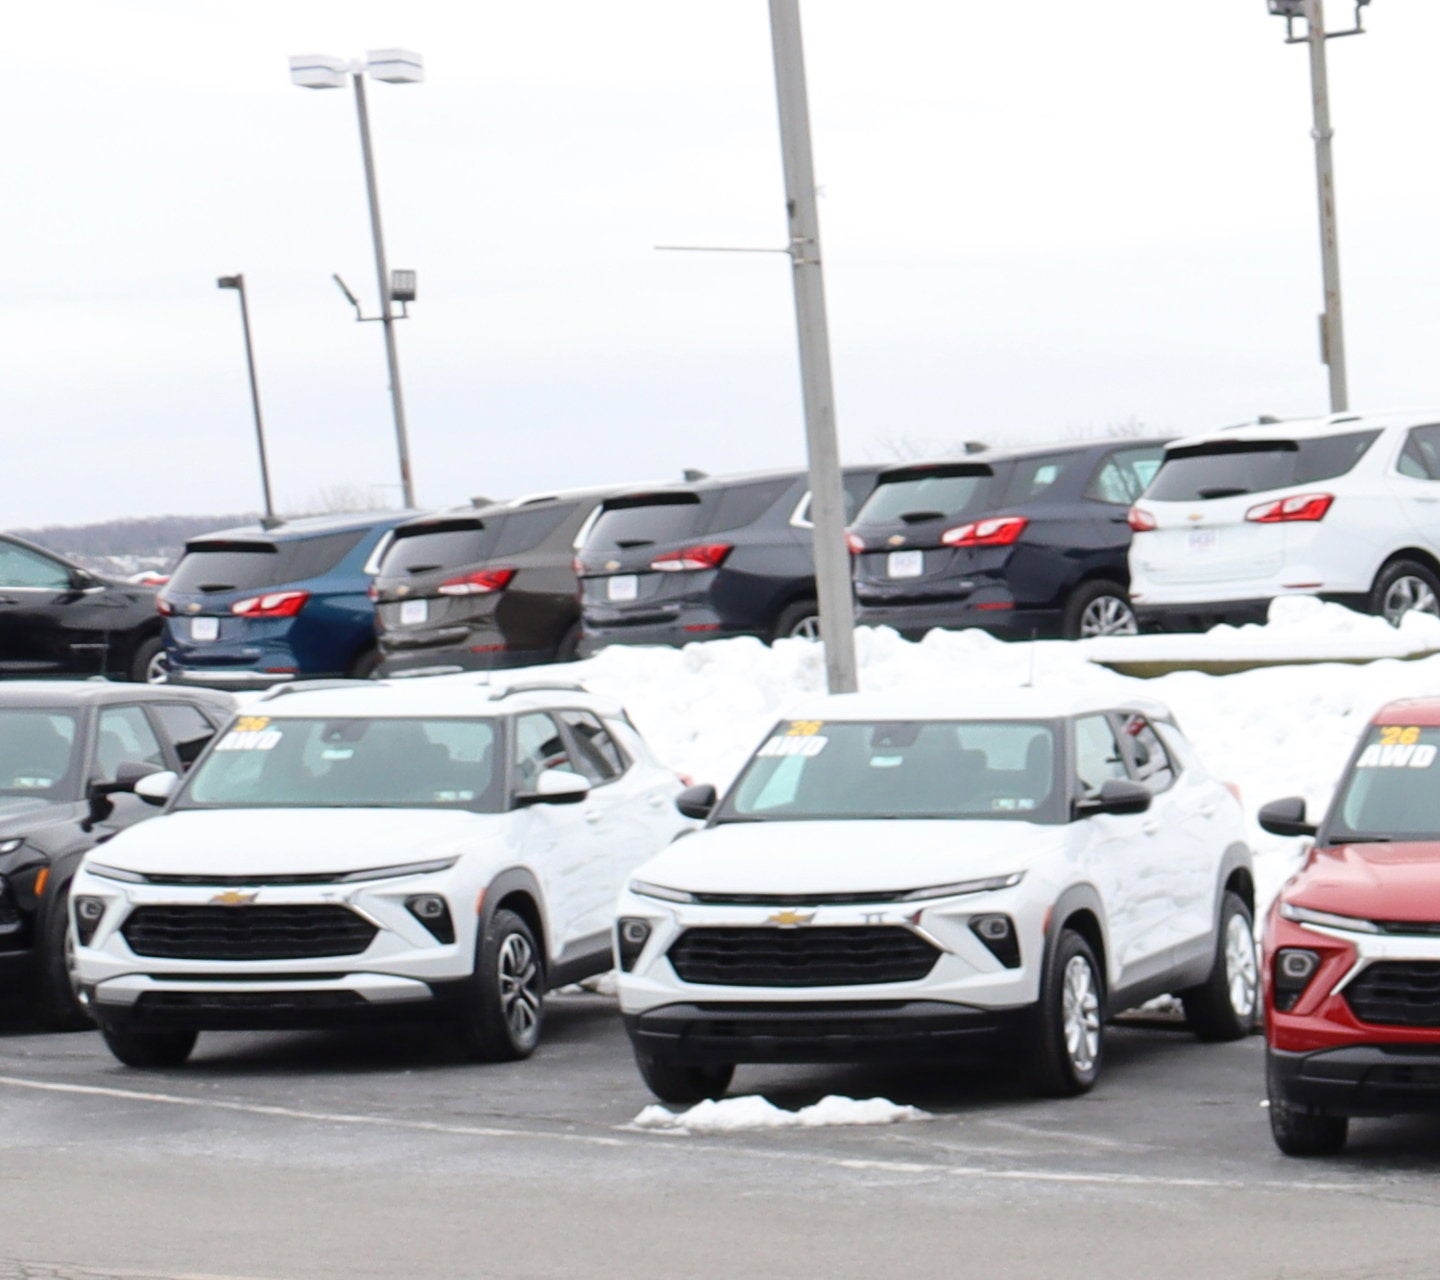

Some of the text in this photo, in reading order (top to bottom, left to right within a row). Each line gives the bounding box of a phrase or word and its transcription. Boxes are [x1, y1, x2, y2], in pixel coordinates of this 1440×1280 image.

[214, 731, 282, 751] AWD
[757, 736, 829, 756] AWD
[1355, 744, 1437, 768] AWD
